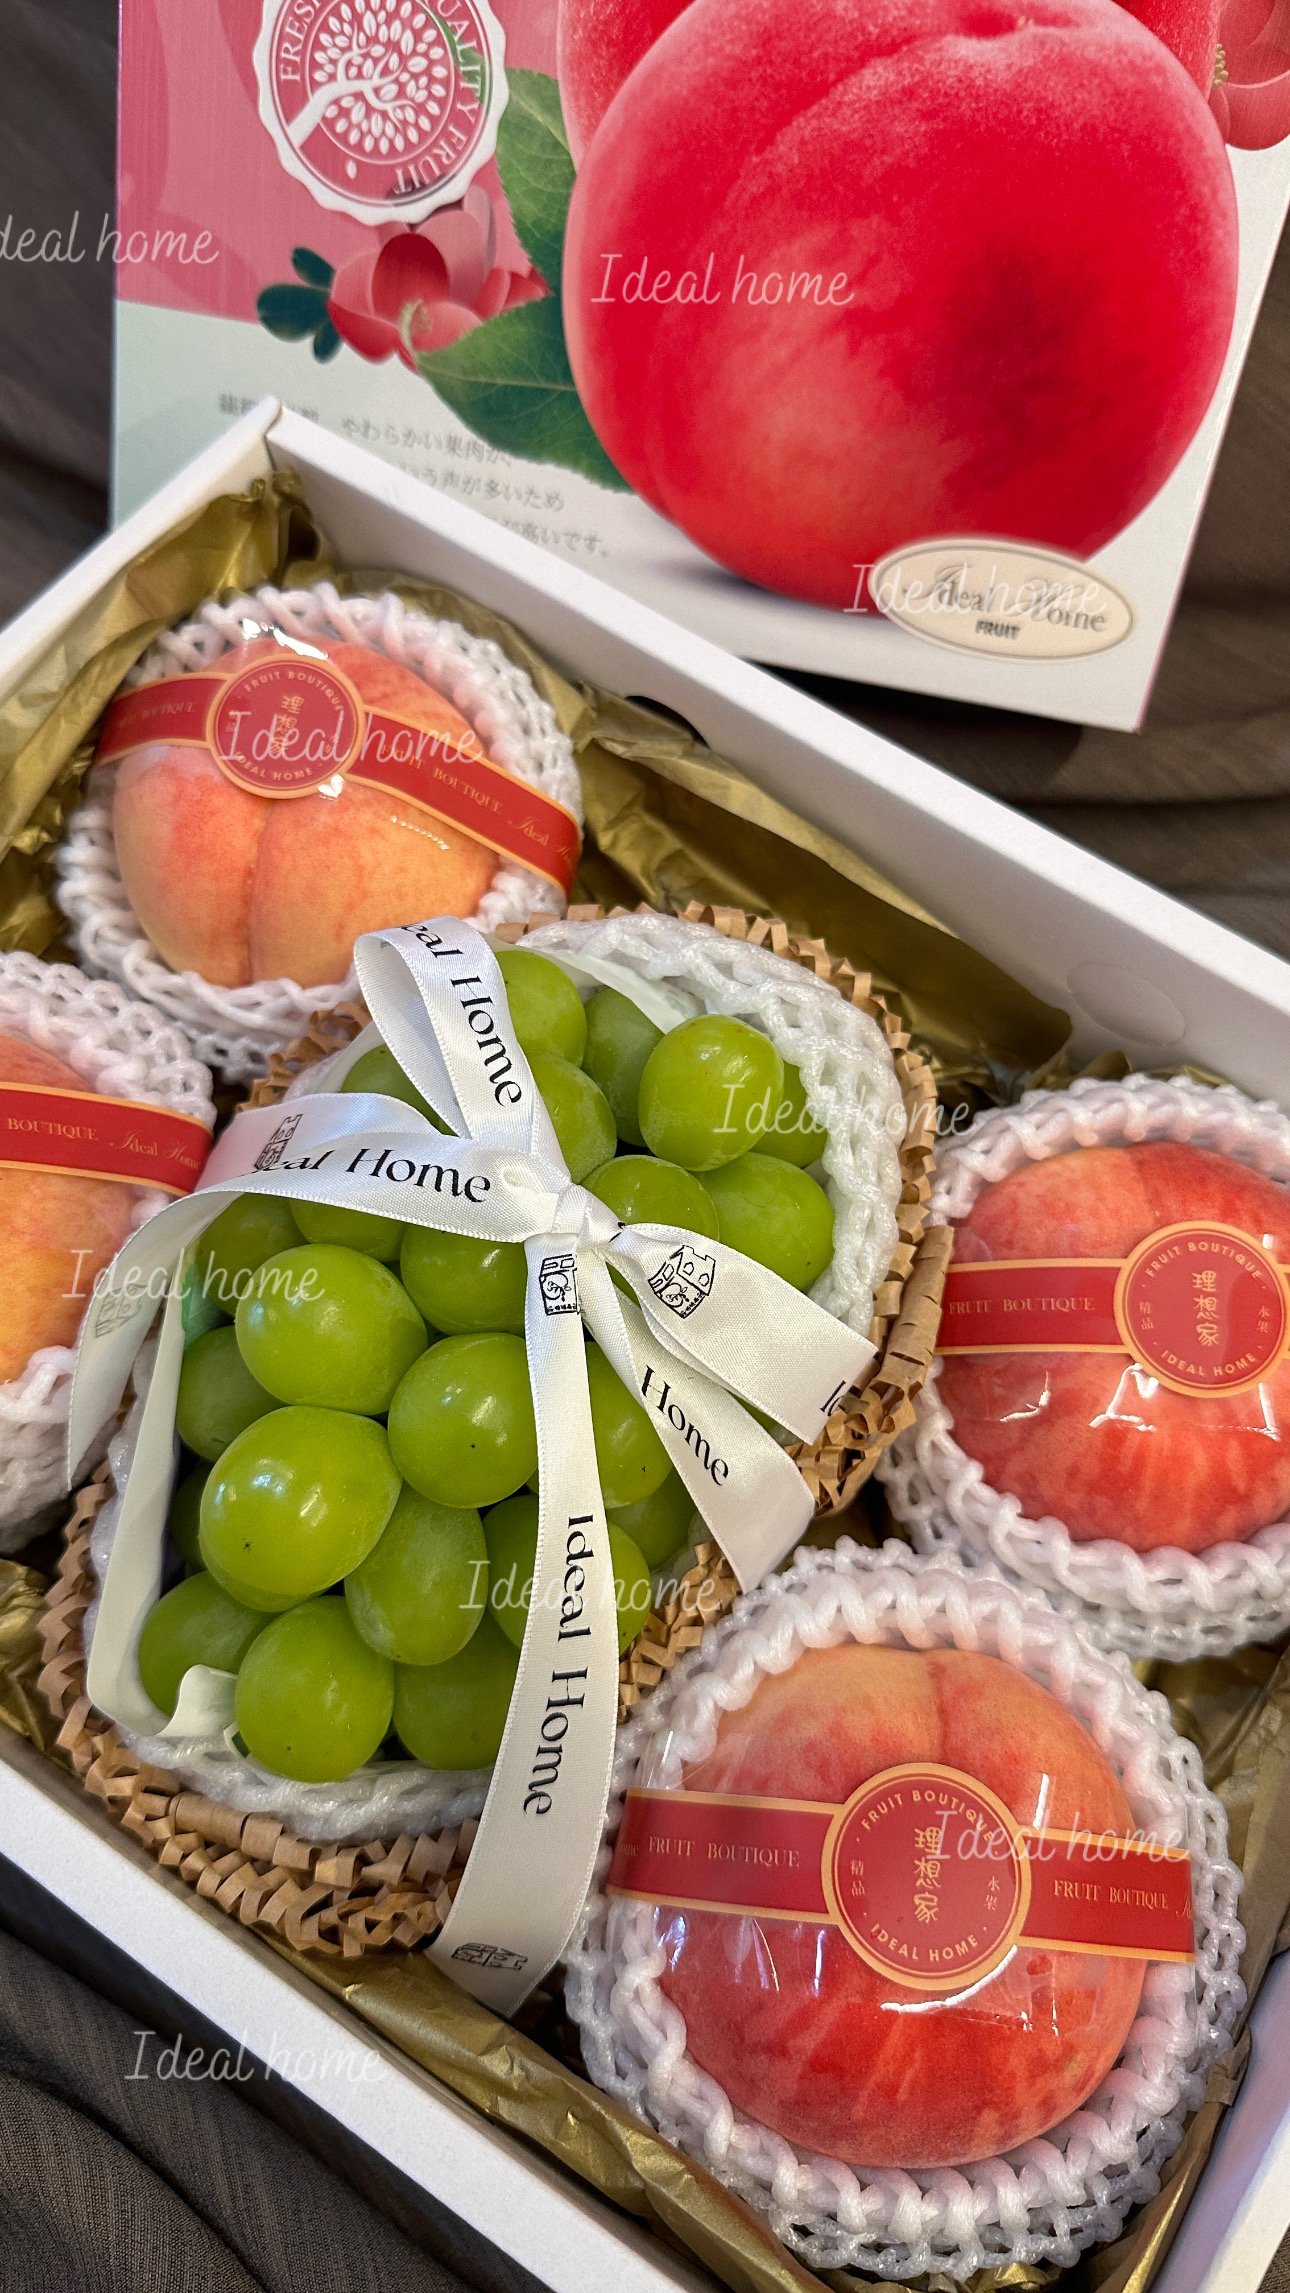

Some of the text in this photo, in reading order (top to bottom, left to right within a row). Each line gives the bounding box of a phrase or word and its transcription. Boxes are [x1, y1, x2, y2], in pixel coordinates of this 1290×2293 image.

[280, 0, 480, 193] FRES UALITY FRUIT
[975, 620, 1021, 639] FRUIT
[244, 671, 344, 711] FRUIT BOUTIQUE
[273, 768, 313, 780] HOME
[433, 768, 502, 814] BOUTIQUE
[401, 923, 522, 1107] eal Home
[8, 1118, 99, 1140] BOUTIQUE
[109, 1131, 158, 1155] Ideal
[346, 1148, 491, 1203] Home
[1145, 1241, 1262, 1279] FRUIT BOUTIQUE
[949, 1297, 1095, 1315] FRUIT BOUTIQUE
[1192, 1270, 1219, 1346] 理想家
[1160, 1350, 1256, 1377] IDEAL HOME
[641, 1365, 729, 1487] Home
[523, 1514, 594, 1816] Ideal Home
[861, 1790, 994, 1842] FRUIT BOUTIQUE
[649, 1836, 695, 1857] FRUIT
[706, 1842, 800, 1868] BOUTIQUE
[913, 1826, 942, 1924] 理想家
[1054, 1879, 1101, 1901] FRUIT
[1109, 1886, 1169, 1910] BOUTIQUE
[870, 1923, 978, 1961] IDEAL HOME
